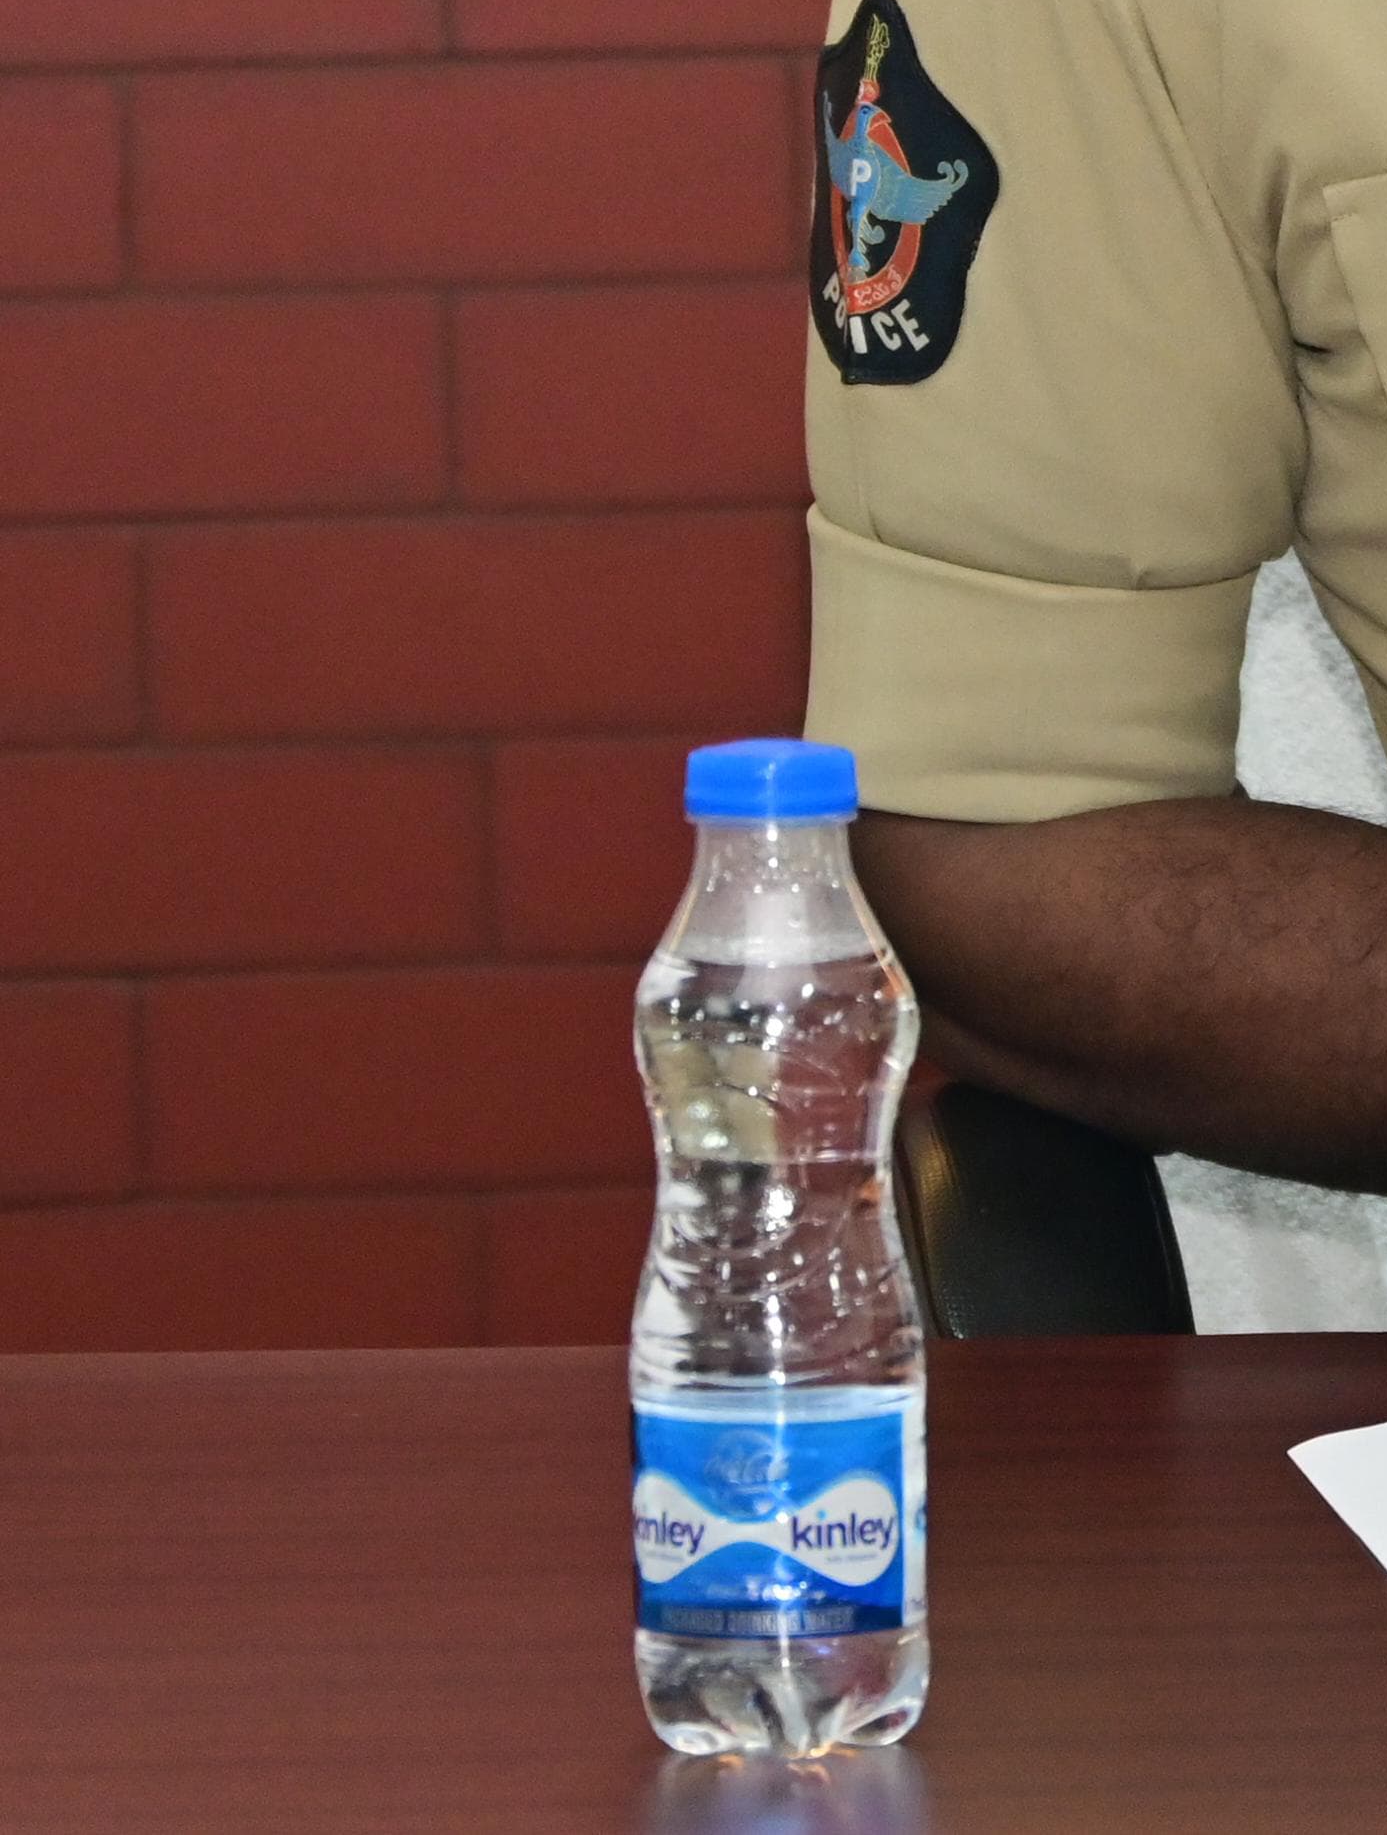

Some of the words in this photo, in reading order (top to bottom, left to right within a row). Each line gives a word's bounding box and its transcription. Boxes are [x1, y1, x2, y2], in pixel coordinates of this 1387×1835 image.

[849, 158, 872, 197] P
[822, 272, 930, 354] POICE
[791, 1509, 897, 1551] kinley
